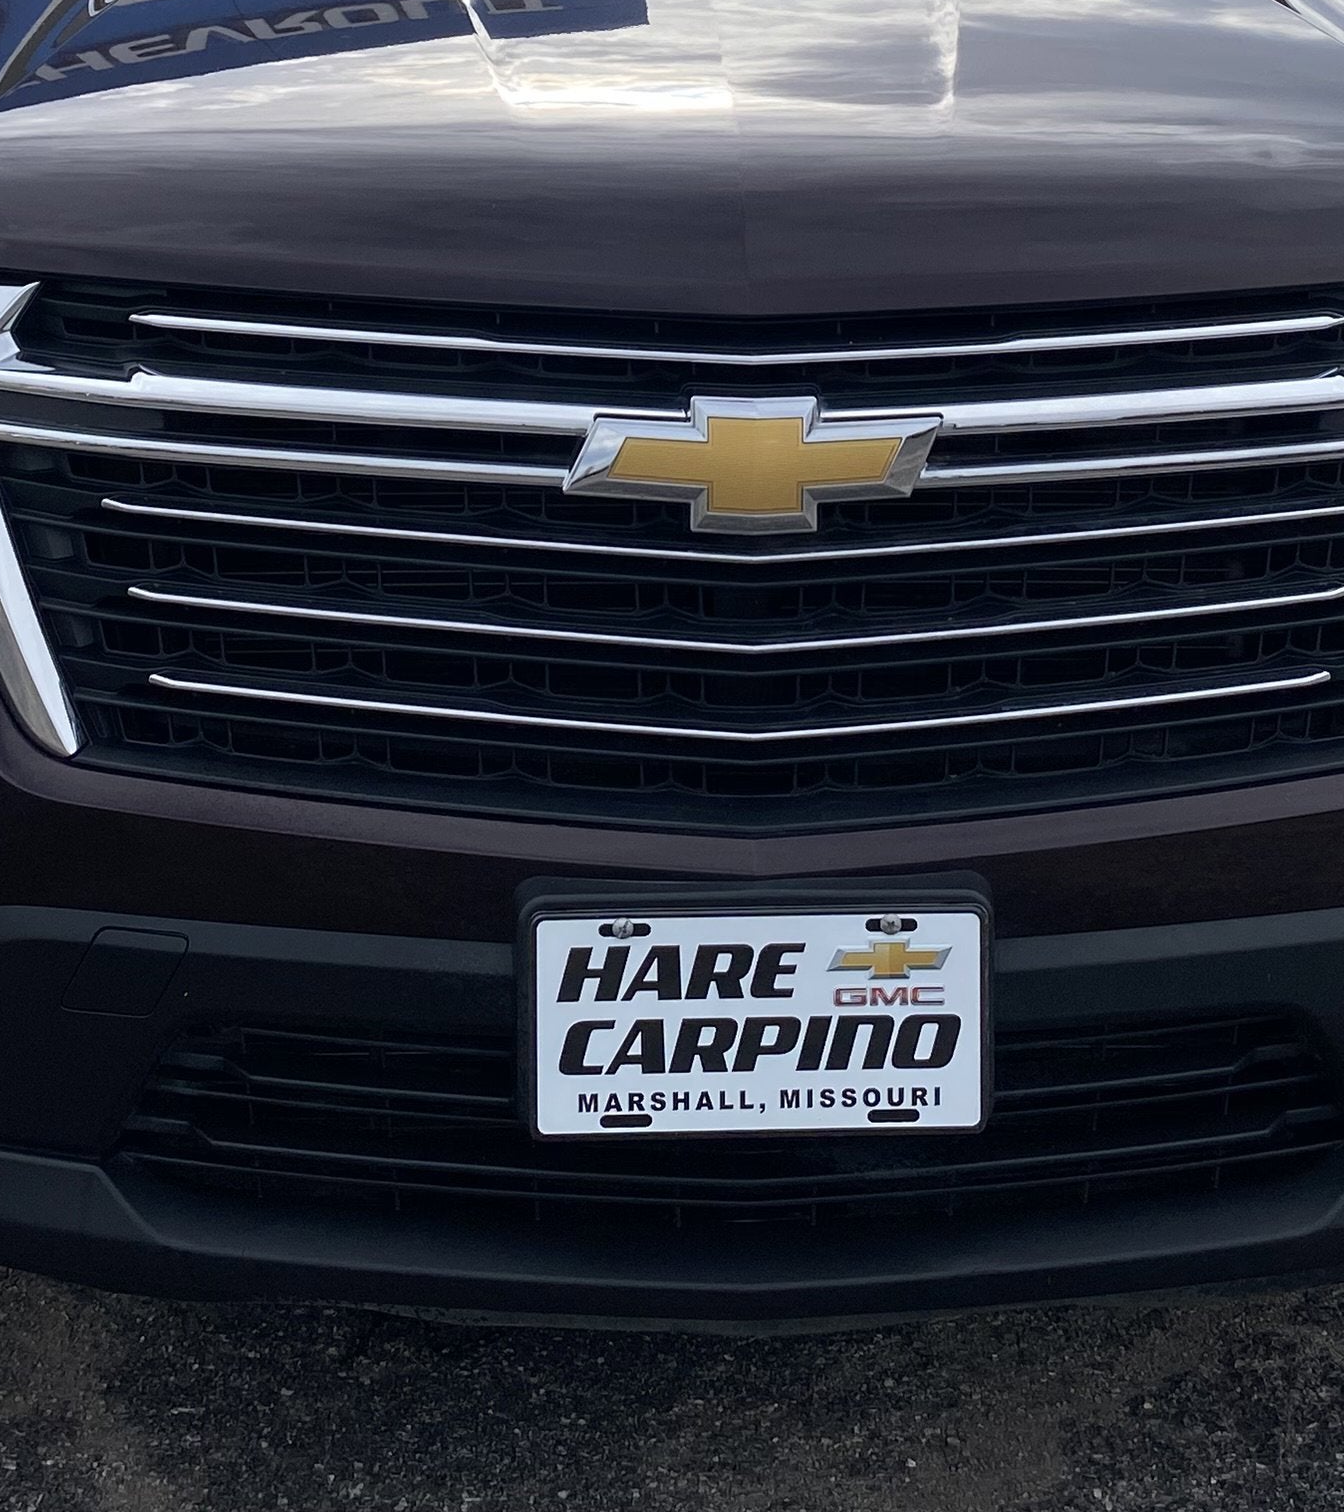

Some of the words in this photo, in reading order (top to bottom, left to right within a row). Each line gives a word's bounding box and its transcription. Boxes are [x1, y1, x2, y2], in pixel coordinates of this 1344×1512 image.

[556, 942, 807, 1003] HARE
[832, 985, 946, 1007] GMC
[558, 1013, 962, 1076] CARPINO
[577, 1089, 767, 1115] MARSHALL,
[779, 1086, 942, 1109] MISSOURI
